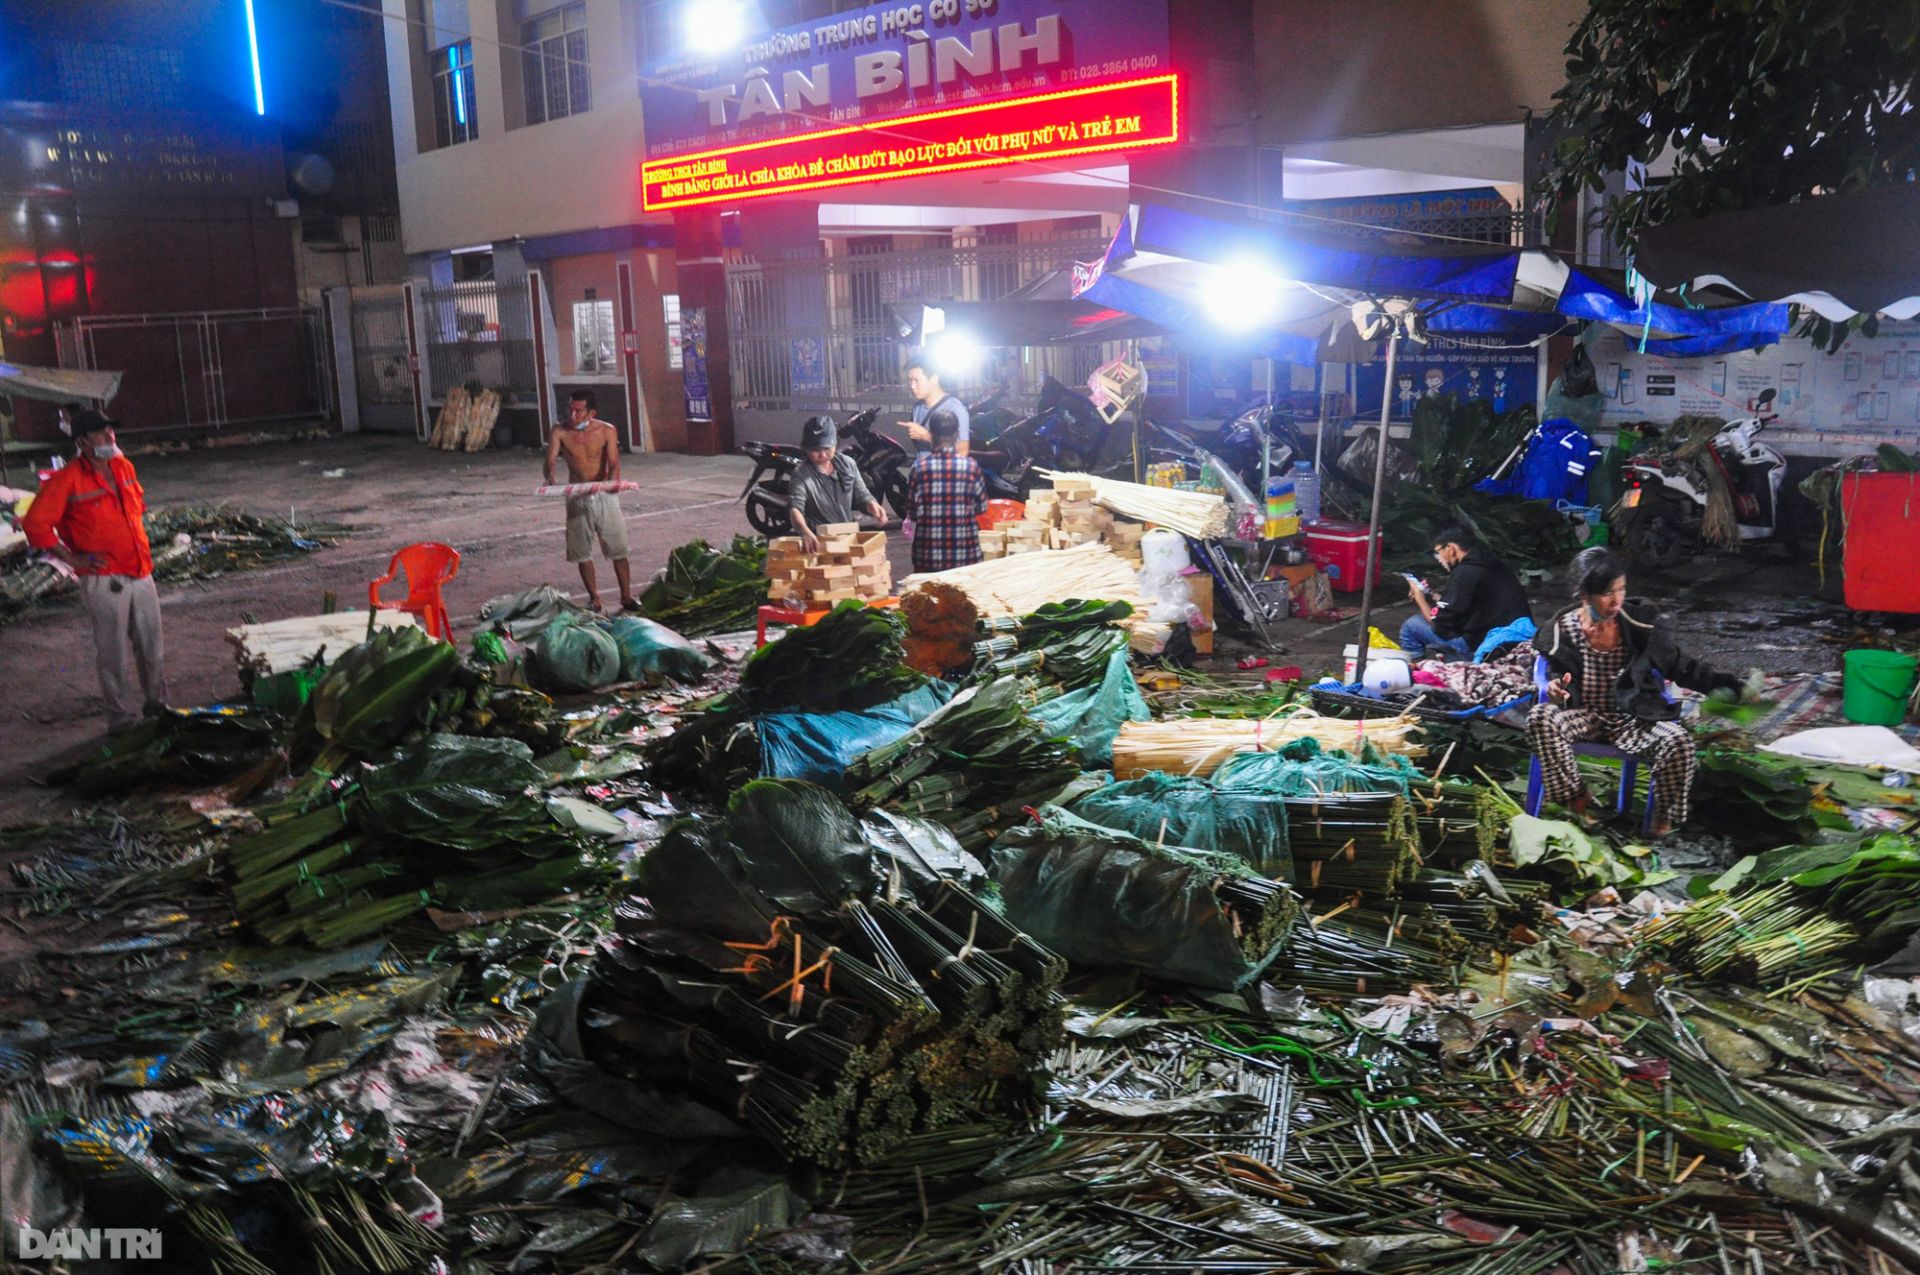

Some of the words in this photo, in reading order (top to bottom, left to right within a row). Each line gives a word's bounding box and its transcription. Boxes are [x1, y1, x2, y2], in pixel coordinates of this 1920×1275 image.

[743, 32, 810, 63] TRƯỜNG
[815, 15, 876, 48] TRUNG
[881, 4, 923, 34] HỌC
[1131, 54, 1158, 69] 0400
[697, 63, 832, 126] TÂN
[854, 14, 1061, 98] BÌNH
[661, 181, 683, 198] BÌNH
[712, 173, 735, 190] GIỚI
[735, 170, 749, 187] LÀ
[750, 166, 775, 184] CHÌA
[776, 161, 808, 181] KHÓA
[809, 157, 825, 176] ĐỂ
[862, 149, 886, 169] DỨT
[888, 148, 915, 167] BẠO
[917, 142, 945, 163] LỰC
[946, 136, 972, 157] ĐỐI
[973, 133, 1000, 152] VỚI
[1000, 131, 1031, 150] PHỤ
[1032, 124, 1056, 145] NỮ
[1057, 120, 1079, 141] VÀ
[1081, 114, 1112, 139] TRẺ
[1115, 115, 1141, 134] EM
